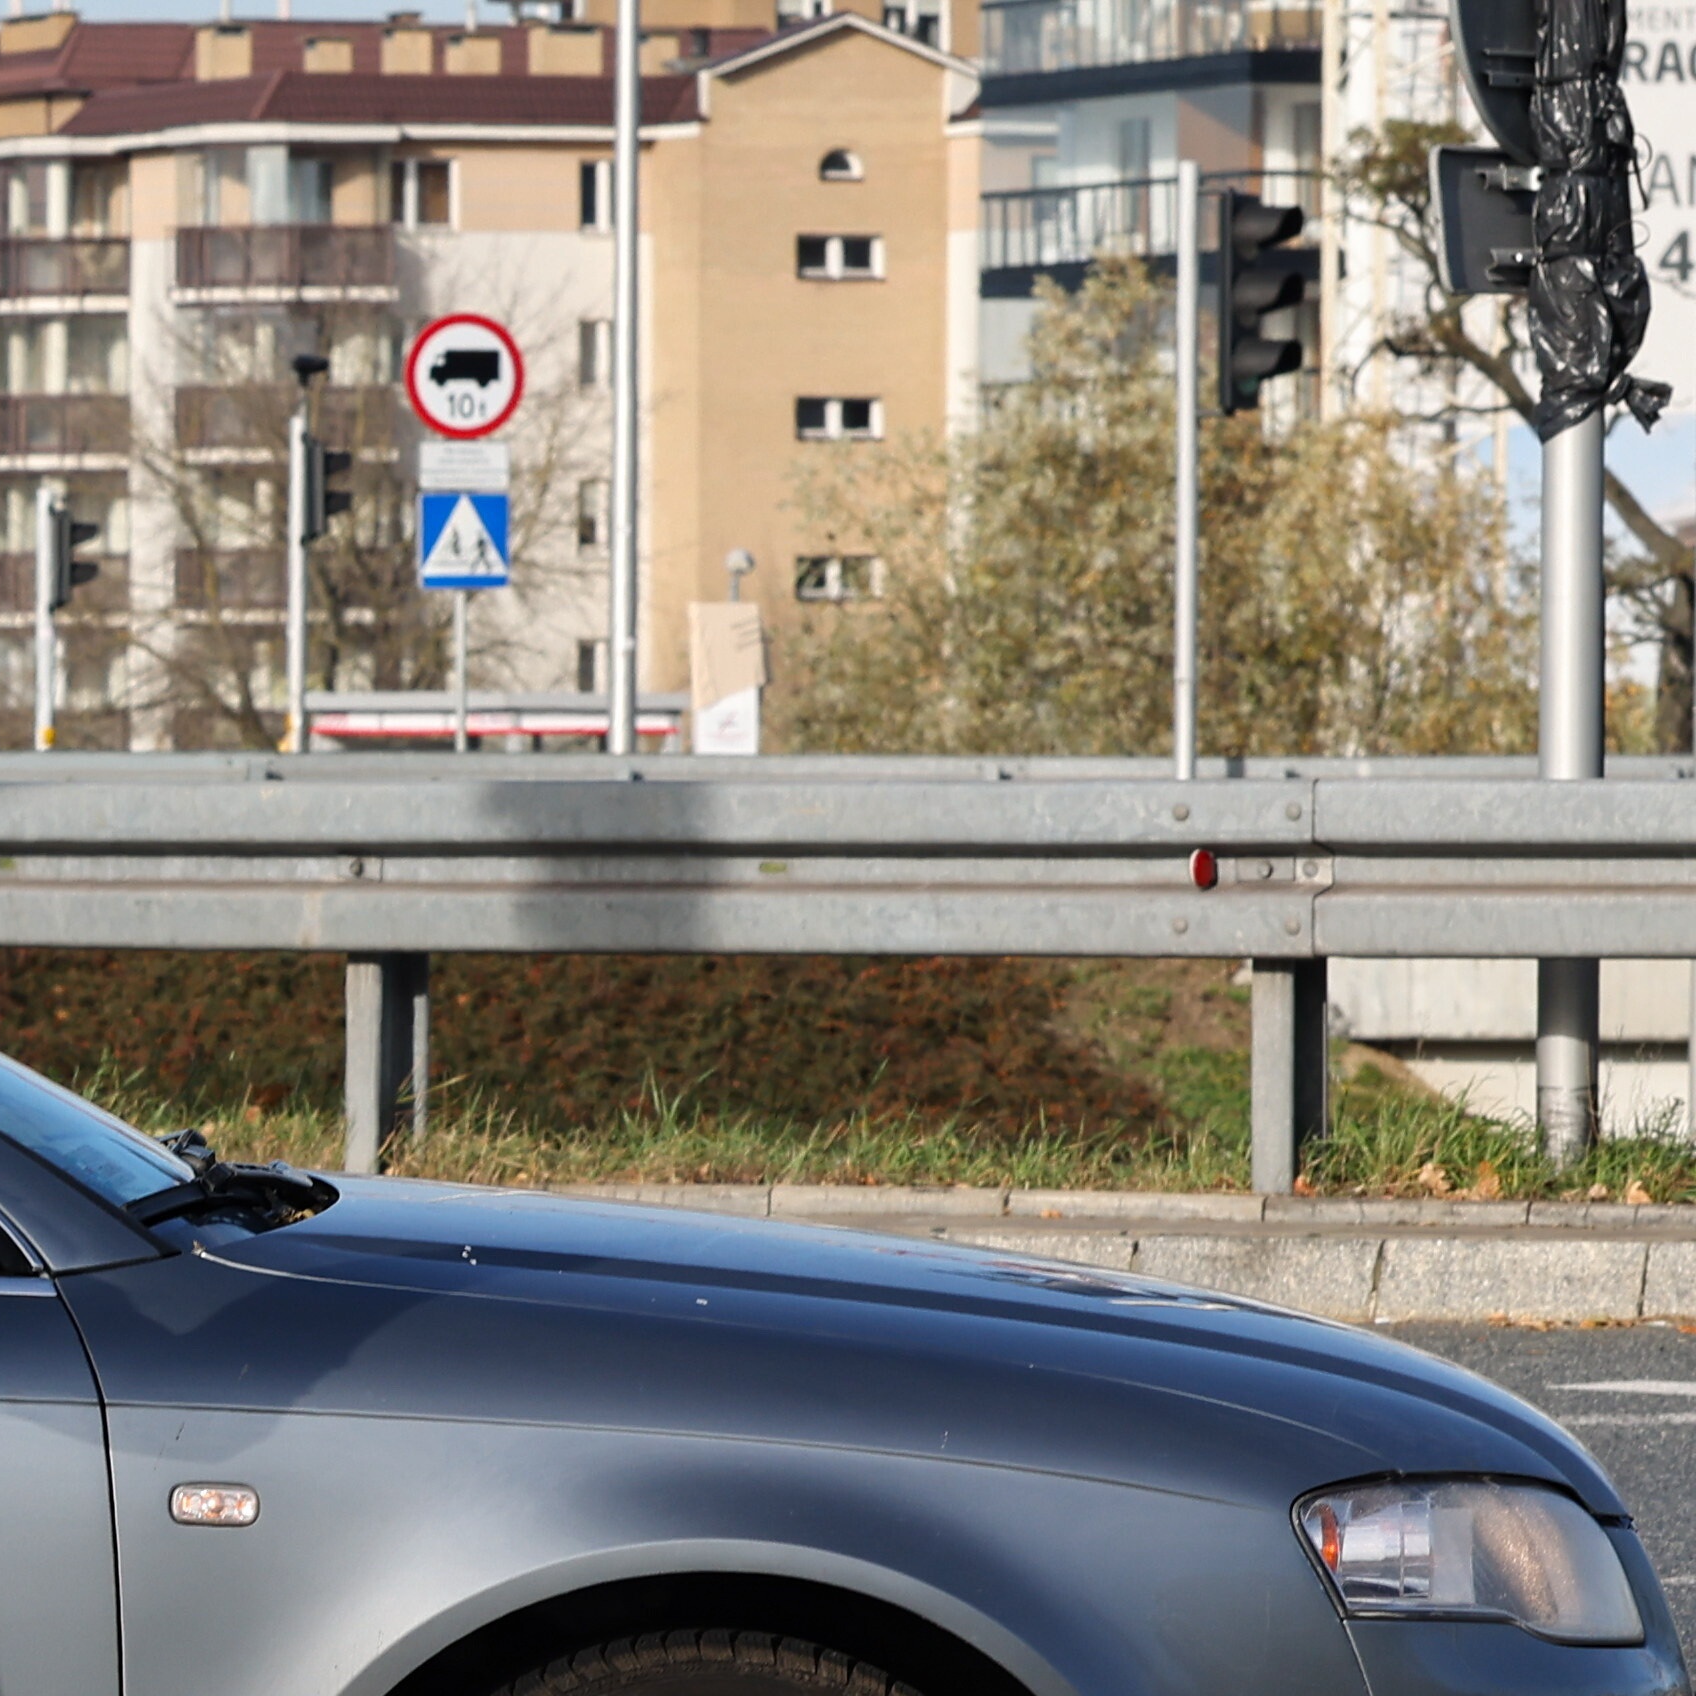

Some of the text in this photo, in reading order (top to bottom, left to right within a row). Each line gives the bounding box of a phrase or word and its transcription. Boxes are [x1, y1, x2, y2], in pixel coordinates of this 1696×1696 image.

[1622, 41, 1696, 83] RA
[1659, 231, 1694, 282] 4
[447, 393, 475, 419] 10
